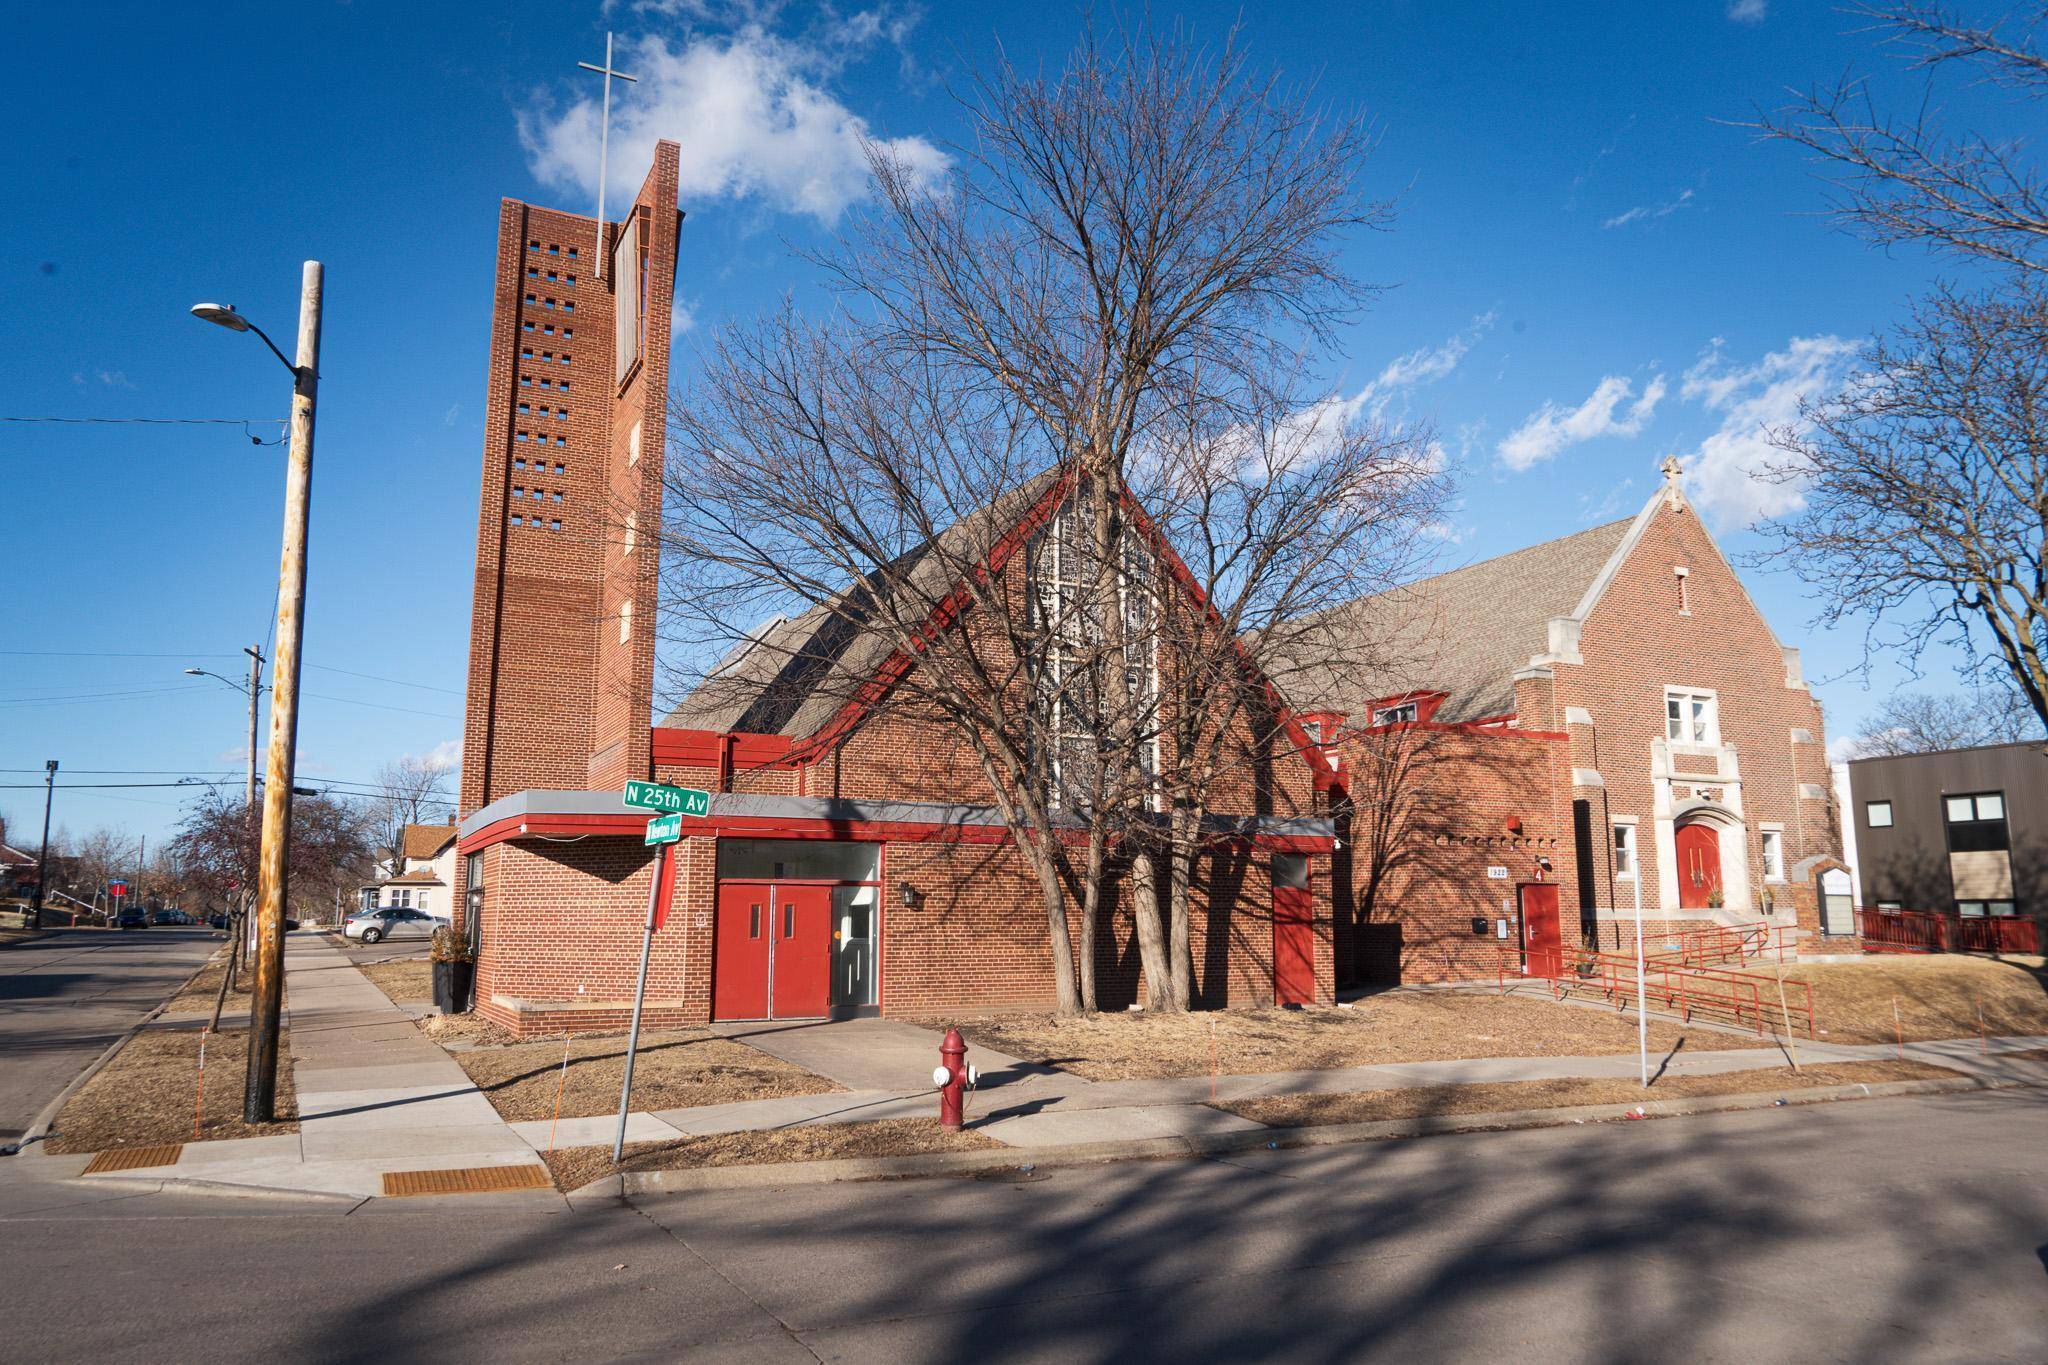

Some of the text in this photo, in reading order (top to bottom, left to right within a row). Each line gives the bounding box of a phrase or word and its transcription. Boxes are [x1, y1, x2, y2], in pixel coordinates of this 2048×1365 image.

[627, 786, 705, 811] N 25th Av
[1535, 870, 1541, 880] 4
